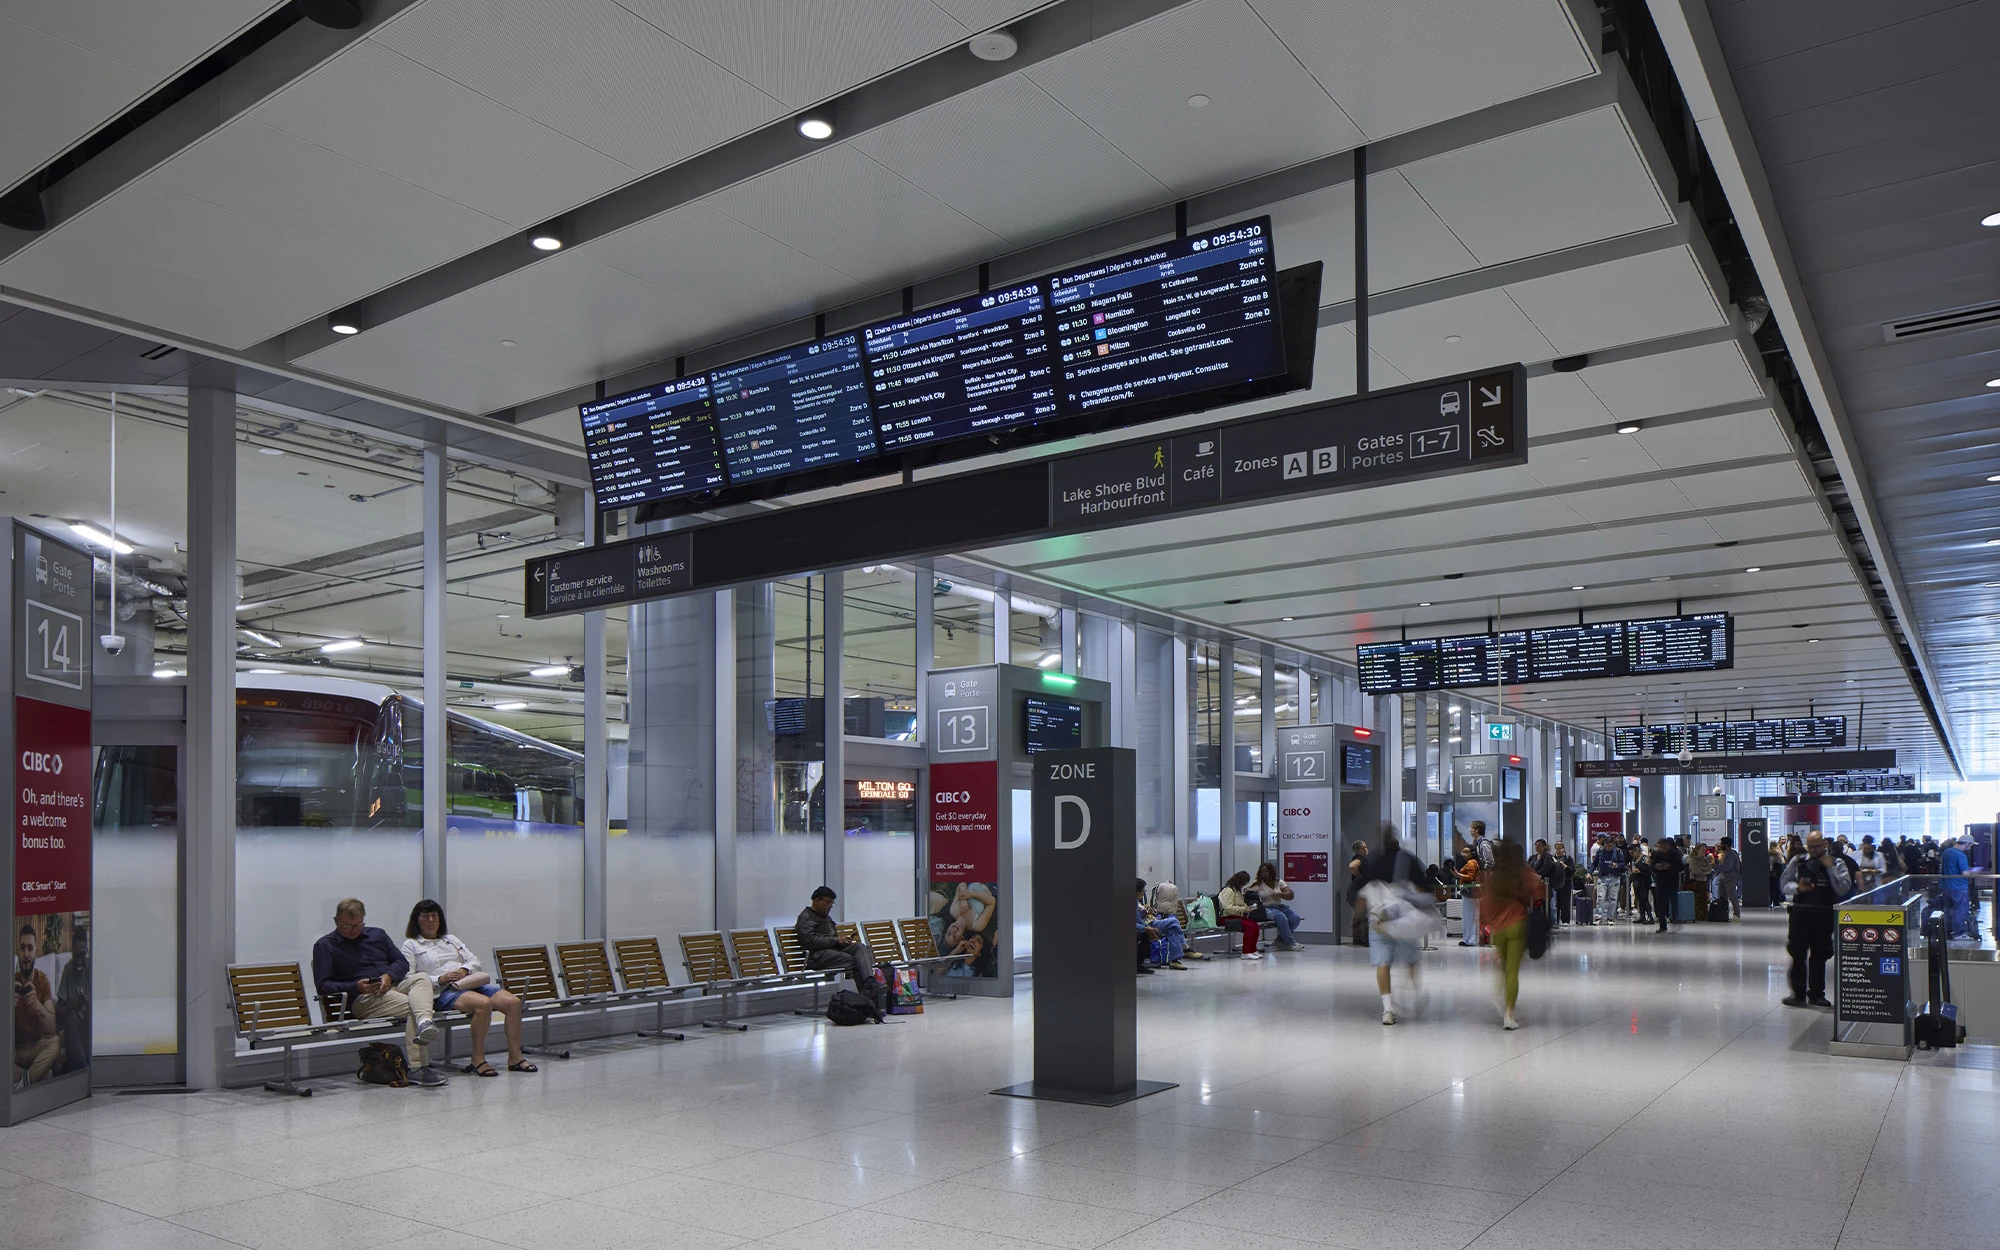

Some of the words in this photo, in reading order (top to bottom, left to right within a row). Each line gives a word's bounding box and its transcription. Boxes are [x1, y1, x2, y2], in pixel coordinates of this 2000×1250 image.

[1213, 226, 1261, 246] 09:54:30
[1074, 269, 1106, 281] Departures
[1110, 259, 1131, 272] Départs
[1133, 257, 1142, 265] des
[1144, 252, 1166, 263] autobus
[1240, 262, 1256, 270] Zone
[1169, 276, 1198, 288] Catharines
[1241, 279, 1257, 287] Zone
[1259, 275, 1266, 283] A
[998, 286, 1038, 303] 09:54:30
[1092, 295, 1116, 307] Niagara
[1117, 291, 1132, 302] Falls
[1164, 297, 1176, 305] Main
[1177, 295, 1185, 303] St.
[1201, 284, 1228, 297] Longwood
[1243, 295, 1259, 304] Zone
[1070, 303, 1085, 312] 11:30
[1105, 307, 1134, 320] Hamilton
[1072, 319, 1087, 327] 11:30
[1166, 310, 1190, 321] Langstaff
[1245, 311, 1261, 320] Zone
[1108, 321, 1148, 336] Bloomington
[1168, 326, 1196, 337] Cooksville
[822, 336, 855, 351] 09:54:30
[1074, 334, 1089, 343] 11:45
[1110, 340, 1129, 351] Milton
[883, 352, 898, 361] 11:30
[900, 348, 918, 356] London
[929, 338, 954, 349] Hamilton
[1076, 350, 1091, 358] 11:55
[1066, 372, 1074, 380] En
[1078, 366, 1100, 377] Service
[1102, 360, 1127, 373] changes
[1129, 357, 1139, 365] are
[1149, 351, 1169, 361] effect.
[1170, 348, 1183, 356] See
[1184, 337, 1233, 354] gotransit.com.
[677, 378, 705, 390] 09:54:30
[1069, 393, 1076, 401] Fr
[1081, 384, 1122, 398] Changements
[1124, 381, 1132, 389] de
[1133, 376, 1156, 387] service
[1167, 368, 1194, 382] vigueur.
[1195, 361, 1228, 374] Consultez
[1082, 391, 1134, 408] gotransit.com/fr.
[756, 407, 765, 415] York
[766, 405, 776, 413] City
[1358, 432, 1404, 450] Gates
[1417, 432, 1452, 452] 1-7
[1235, 454, 1278, 473] Zones
[1289, 458, 1302, 475] A
[1318, 453, 1332, 470] B
[1352, 450, 1404, 469] Portes
[1184, 465, 1214, 481] Café
[1063, 486, 1092, 503] Lake
[1095, 480, 1132, 498] Shore
[1136, 474, 1165, 489] Blvd
[1081, 490, 1165, 515] Harbourfront
[53, 561, 72, 580] Gate
[638, 561, 684, 577] Washrooms
[53, 578, 75, 598] Porte
[550, 581, 584, 593] Customer
[586, 575, 612, 586] service
[638, 576, 671, 589] Toilettes
[550, 593, 575, 605] Service
[577, 590, 582, 598] à
[584, 590, 590, 598] la
[593, 584, 625, 597] clientèle
[38, 618, 68, 673] 14
[960, 680, 978, 688] Gate
[961, 689, 981, 697] Porte
[302, 699, 355, 712] 89010
[947, 715, 976, 745] 13
[23, 751, 50, 773] CIBC
[1293, 757, 1316, 776] 12
[1051, 763, 1095, 780] ZONE
[859, 781, 894, 791] MILTON
[1469, 778, 1482, 793] 11
[23, 788, 39, 807] Oh,
[40, 791, 56, 805] and
[58, 791, 84, 807] there's
[936, 792, 959, 803] CIBC
[1597, 794, 1612, 805] 10
[936, 812, 946, 820] Get
[948, 812, 956, 820] $0
[958, 812, 986, 821] everyday
[1283, 808, 1302, 816] CIBC
[1709, 808, 1715, 816] 9
[23, 816, 28, 827] a
[30, 813, 67, 828] welcome
[936, 823, 959, 832] banking
[1055, 795, 1090, 849] D
[23, 835, 47, 849] bonus
[49, 836, 65, 849] too.
[1748, 830, 1761, 844] C
[22, 882, 35, 891] CIBC
[54, 881, 66, 889] Start
